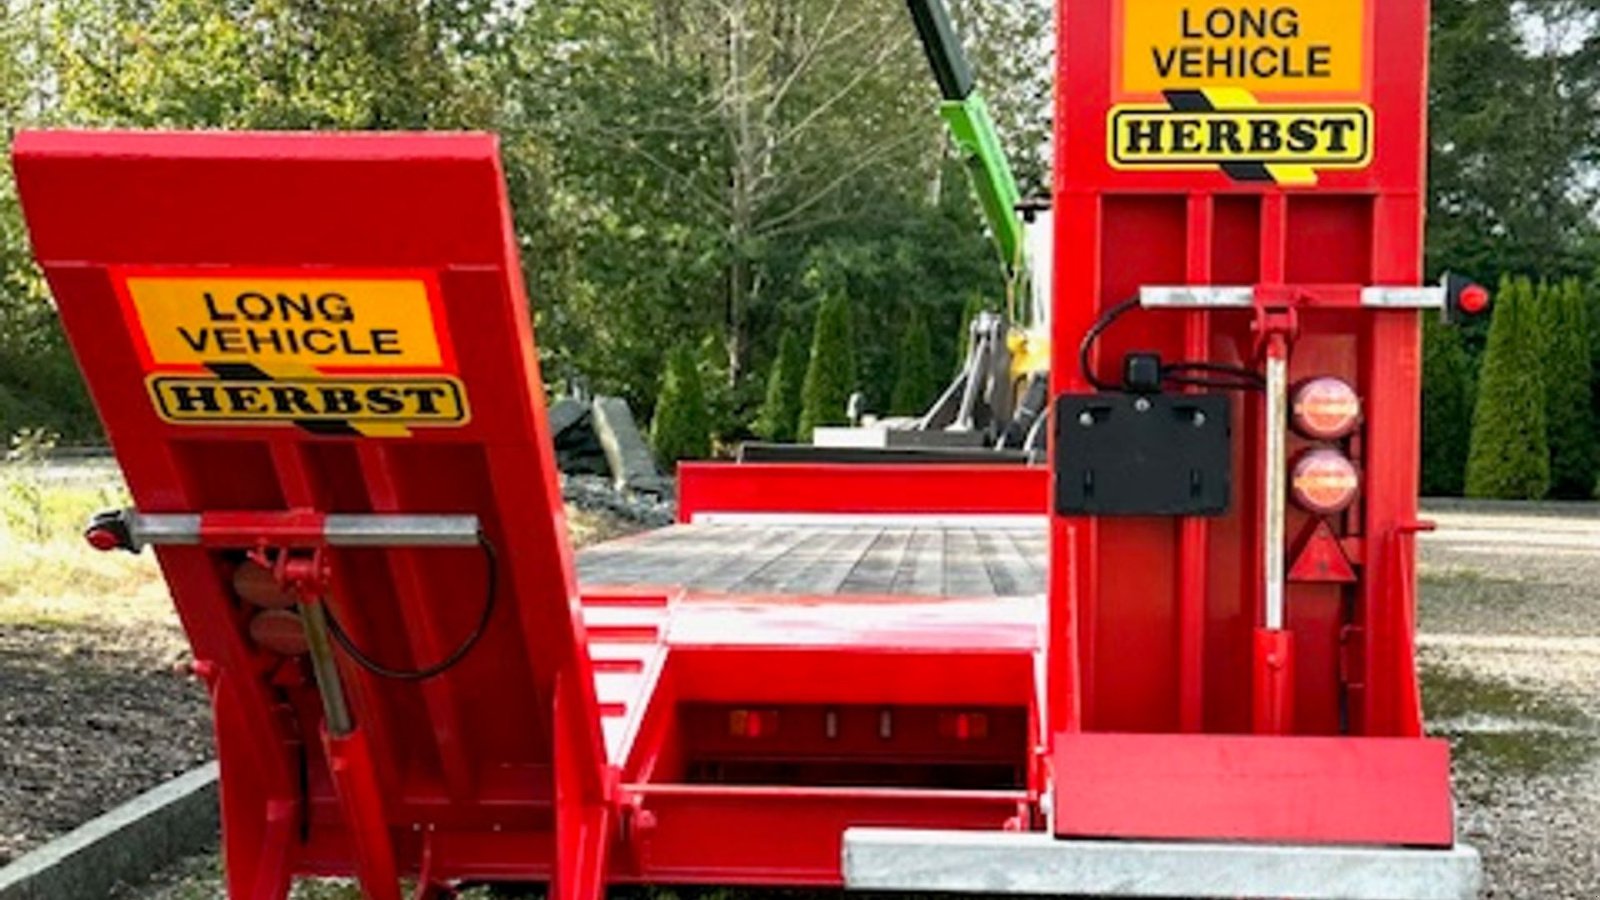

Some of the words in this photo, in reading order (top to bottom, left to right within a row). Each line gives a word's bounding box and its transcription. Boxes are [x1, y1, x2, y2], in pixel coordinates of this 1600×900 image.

[1181, 8, 1299, 39] LONG
[1151, 46, 1332, 78] VEHICLE
[1125, 119, 1355, 154] HERBST
[203, 292, 355, 323] LONG
[177, 326, 404, 355] VEHICLE
[169, 385, 445, 415] HERBST
